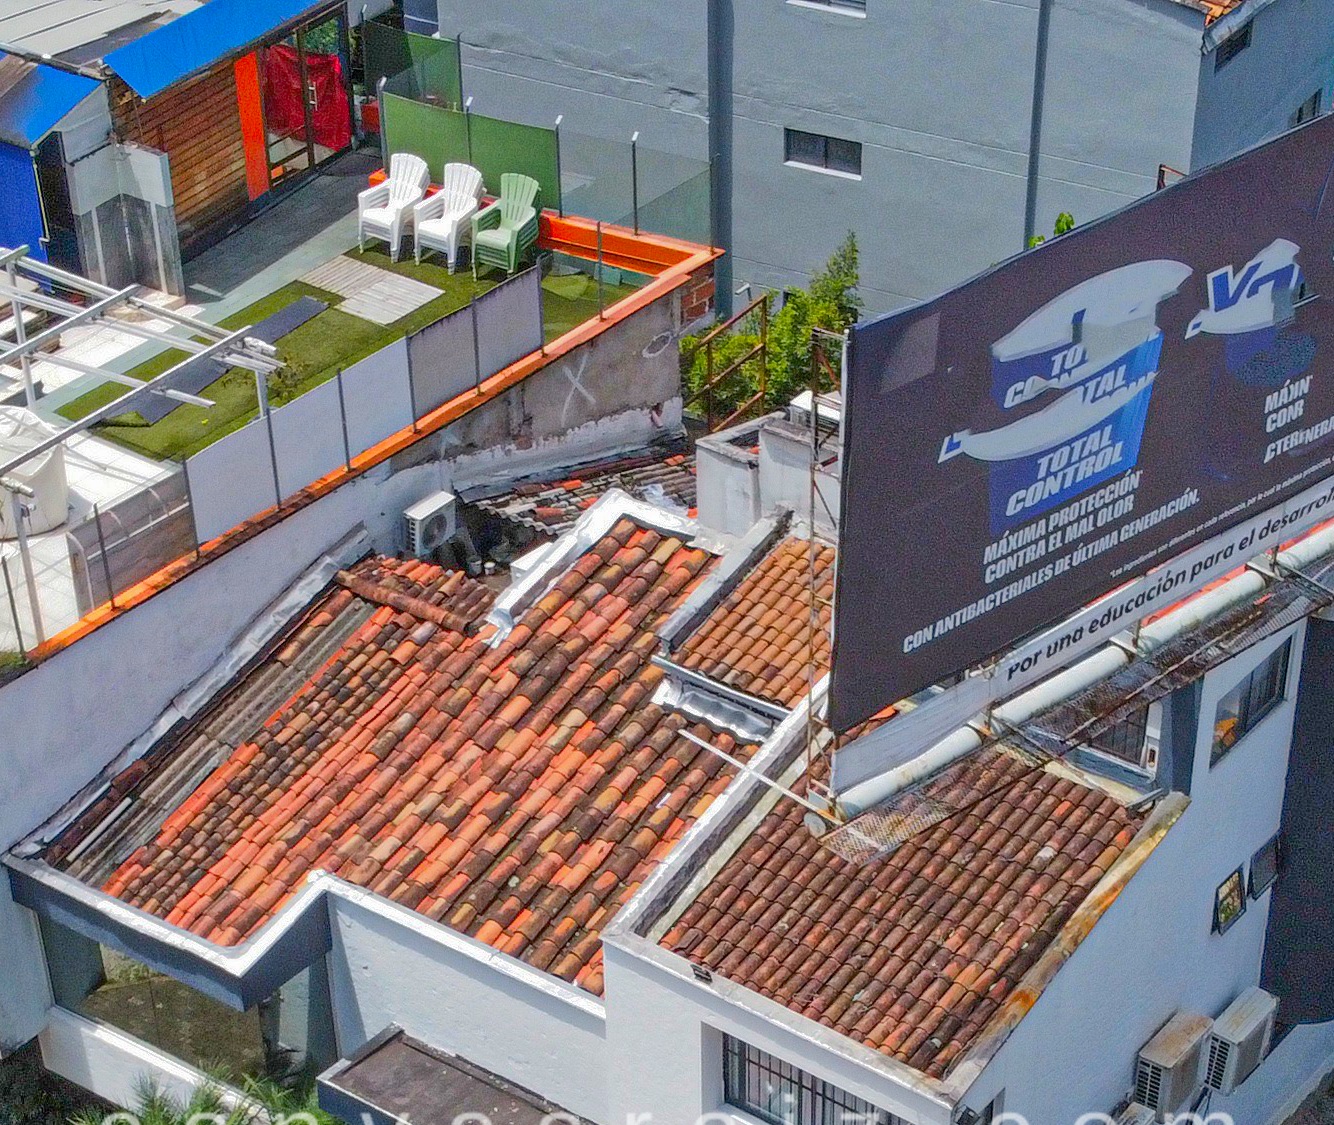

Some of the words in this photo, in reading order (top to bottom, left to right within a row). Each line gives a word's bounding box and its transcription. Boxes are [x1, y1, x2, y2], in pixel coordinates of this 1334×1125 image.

[1005, 441, 1124, 517] CONTROL
[1037, 424, 1114, 480] TOTAL
[983, 518, 1046, 565] MÁXIMA
[984, 542, 1047, 585] CONTRA
[1048, 535, 1064, 558] EL
[1065, 521, 1095, 549] MAL
[1097, 494, 1135, 527] OLOR
[903, 625, 935, 654] CON
[934, 567, 1054, 638] ANTIBACTERIALES
[1054, 557, 1072, 578] DE
[1072, 528, 1118, 568] ÚLTIMA
[1006, 654, 1042, 682] Por
[1046, 626, 1084, 659] una
[1087, 569, 1186, 635] educación
[1189, 541, 1235, 583] para
[1237, 528, 1257, 551] el
